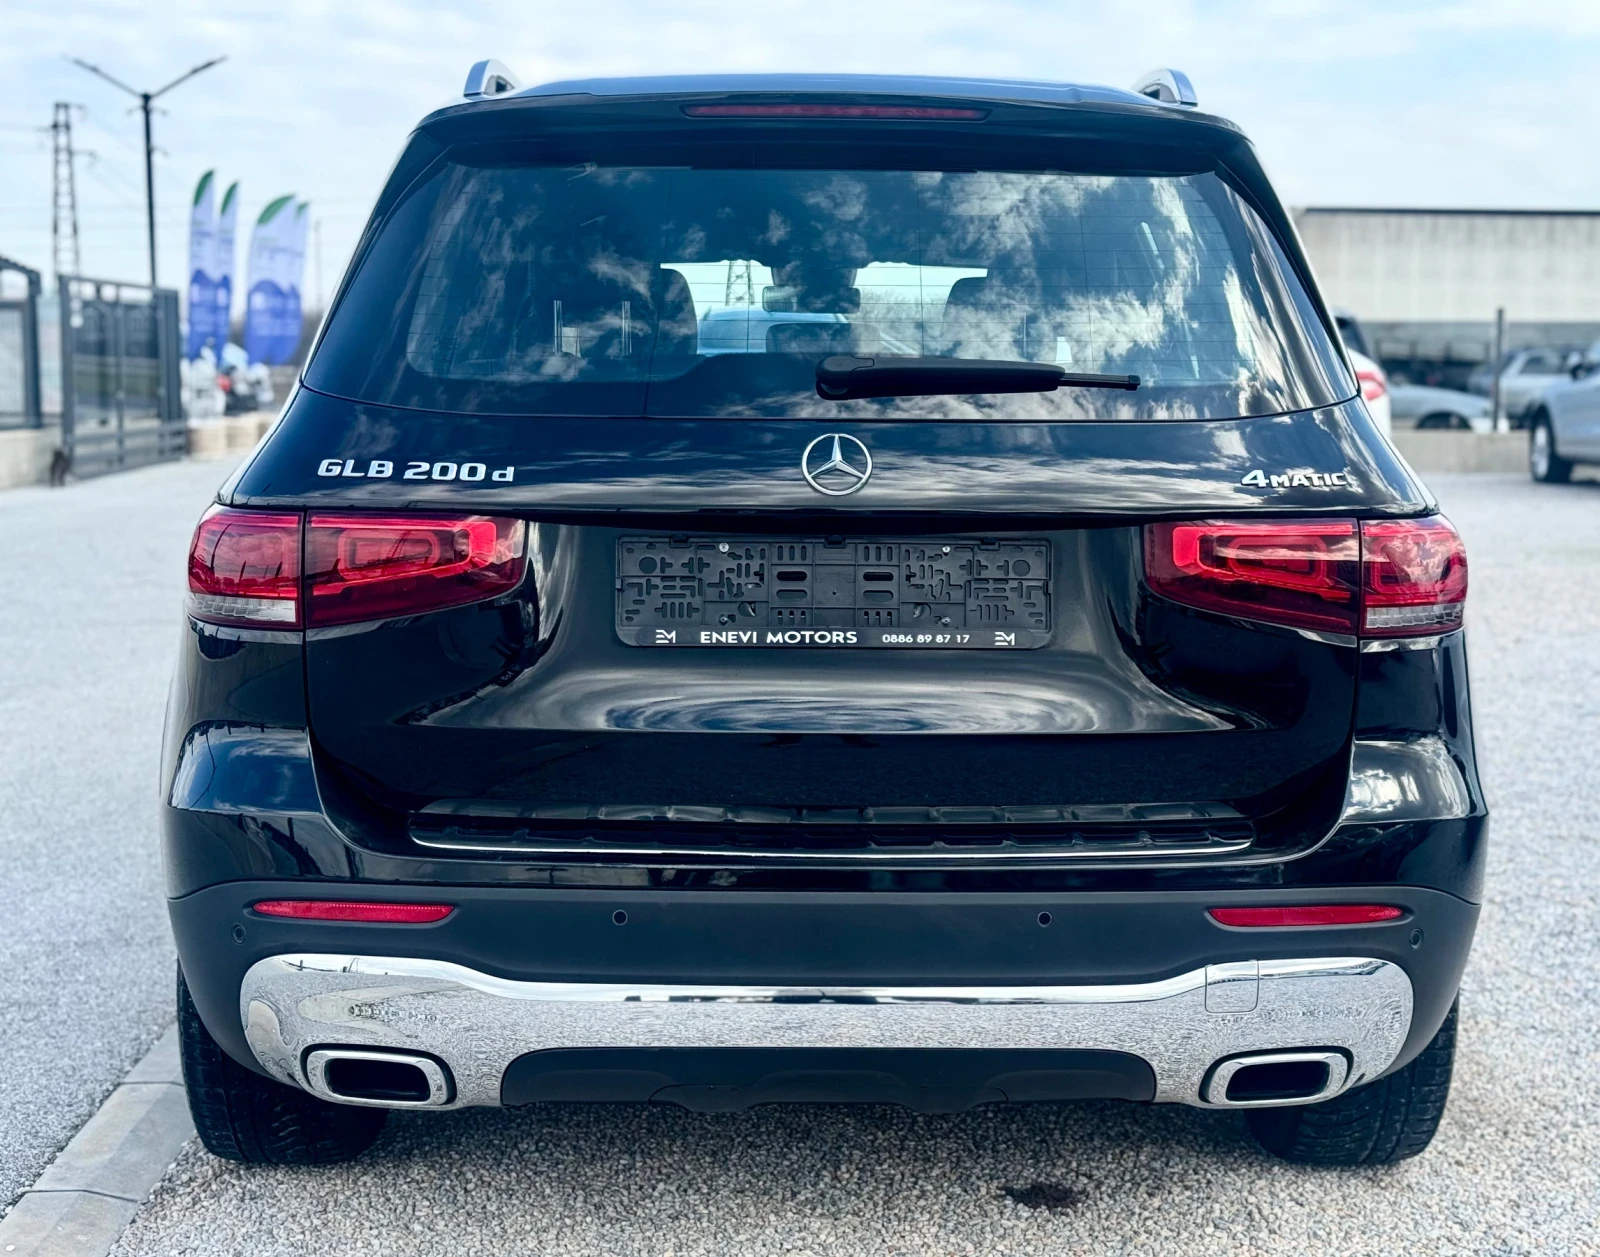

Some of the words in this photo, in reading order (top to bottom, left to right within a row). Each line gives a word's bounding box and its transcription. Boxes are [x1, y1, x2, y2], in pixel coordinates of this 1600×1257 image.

[317, 459, 394, 478] GLB
[403, 461, 487, 481] 200
[492, 466, 515, 482] d
[1241, 469, 1347, 488] 4MATIC
[700, 631, 757, 644] ENEVI
[766, 631, 858, 644] MOTORS
[882, 634, 913, 643] 0886
[916, 634, 933, 644] 89
[935, 634, 951, 644] 87
[956, 634, 970, 644] 17
